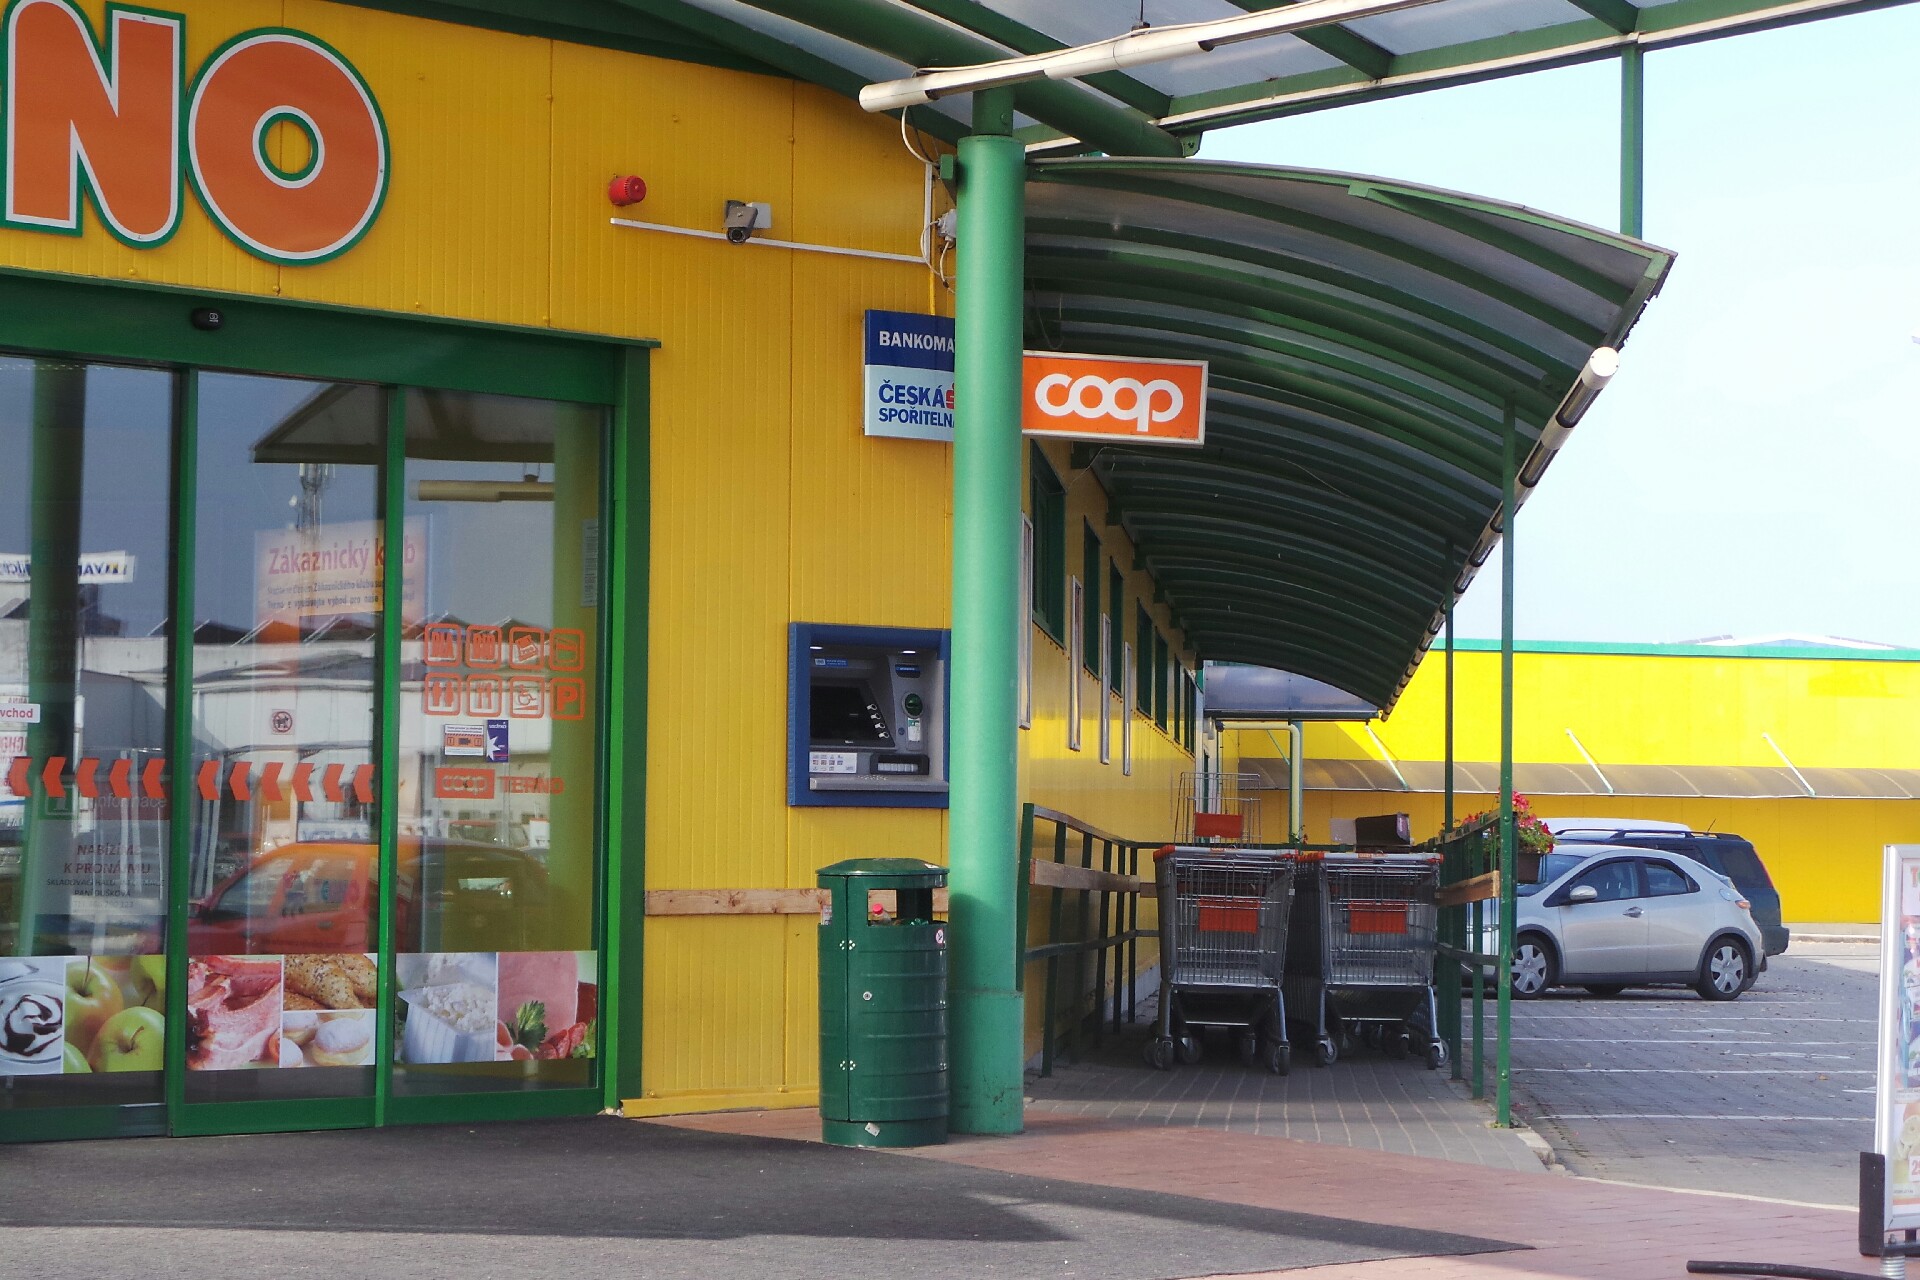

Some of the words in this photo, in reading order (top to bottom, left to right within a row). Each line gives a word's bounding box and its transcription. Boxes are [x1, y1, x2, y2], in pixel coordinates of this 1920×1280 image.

[0, 0, 391, 267] NO
[879, 330, 955, 354] BANKOMA
[878, 374, 946, 409] ČESKÁ
[1034, 373, 1184, 432] coop
[878, 408, 955, 429] SPOŘITELN
[268, 539, 370, 576] Zákaznický
[374, 536, 416, 567] kb
